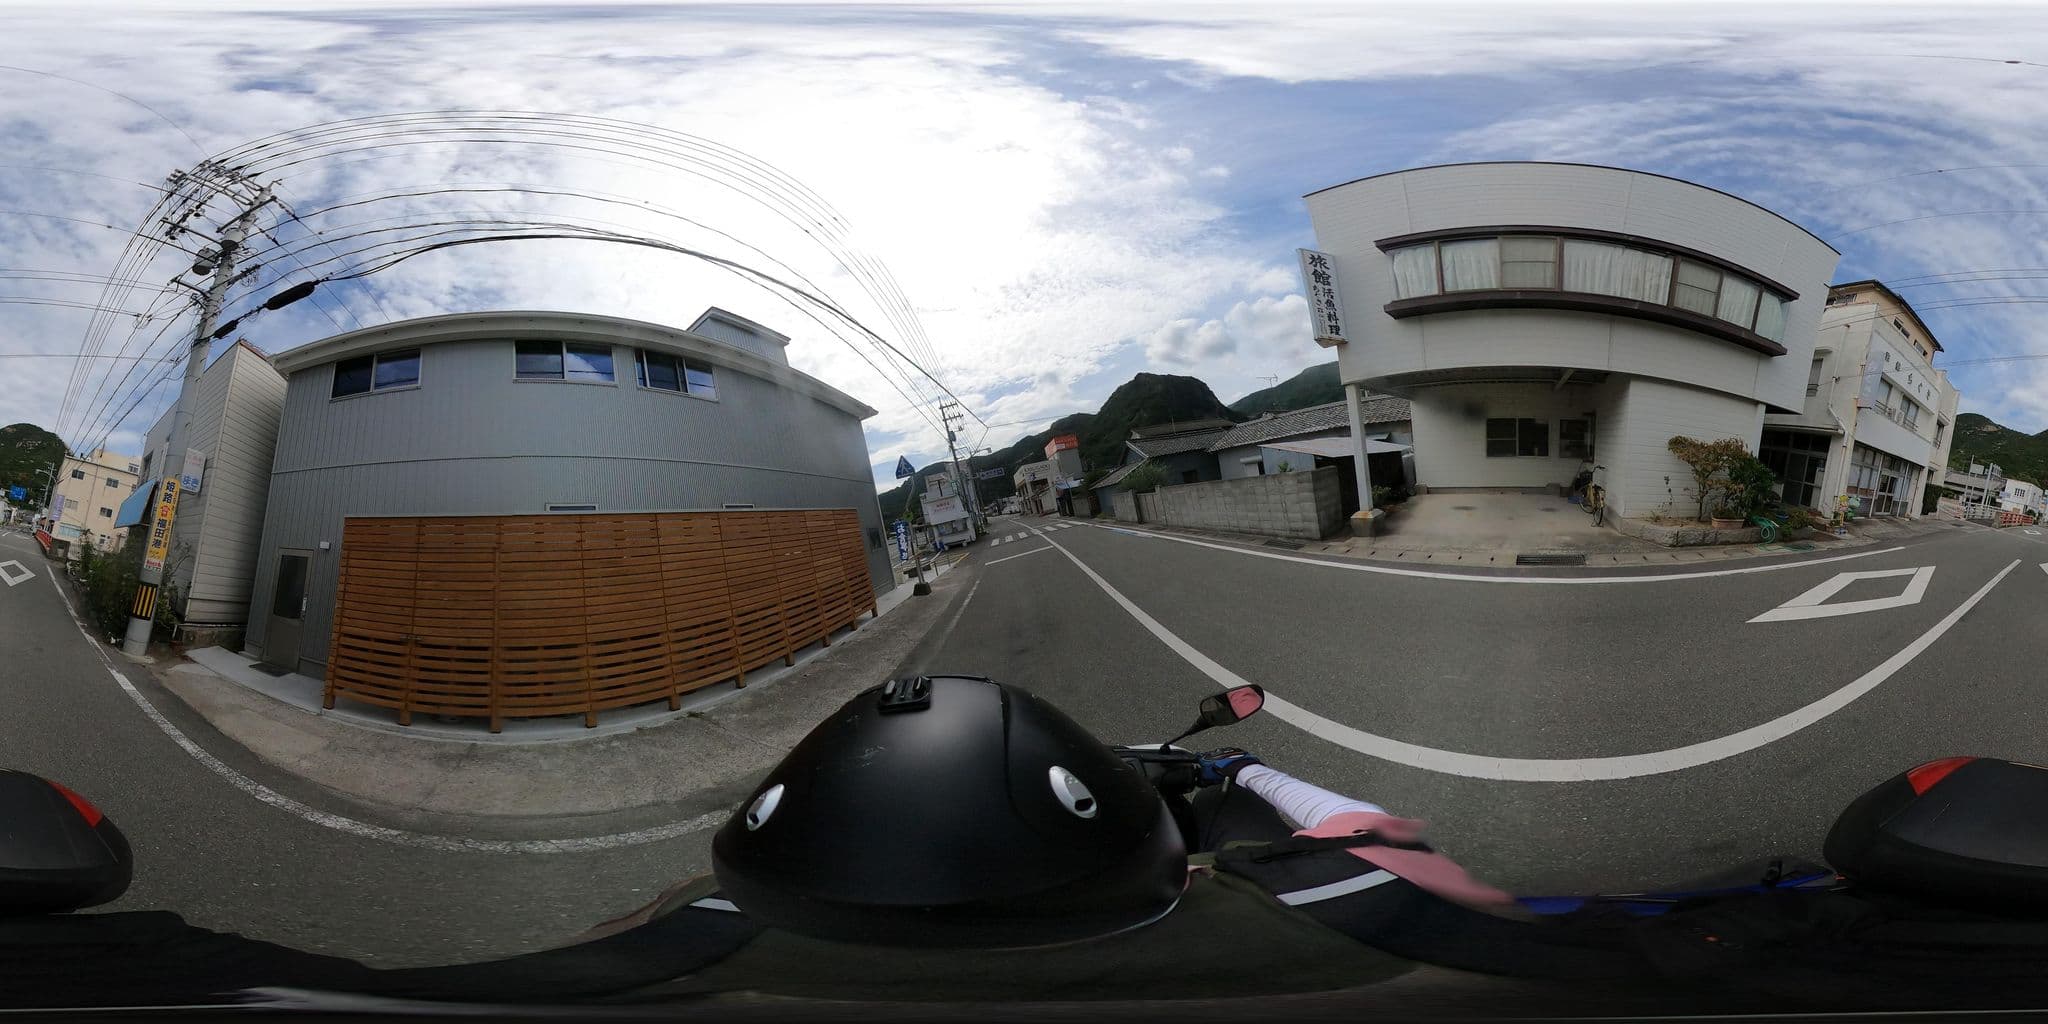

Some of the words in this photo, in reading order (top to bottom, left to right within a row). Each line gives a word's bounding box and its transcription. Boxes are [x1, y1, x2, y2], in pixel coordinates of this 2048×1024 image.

[1309, 254, 1331, 286] 旅館
[1323, 287, 1341, 336] 活魚料理
[162, 481, 176, 504] 姫路
[151, 518, 168, 549] 福田港
